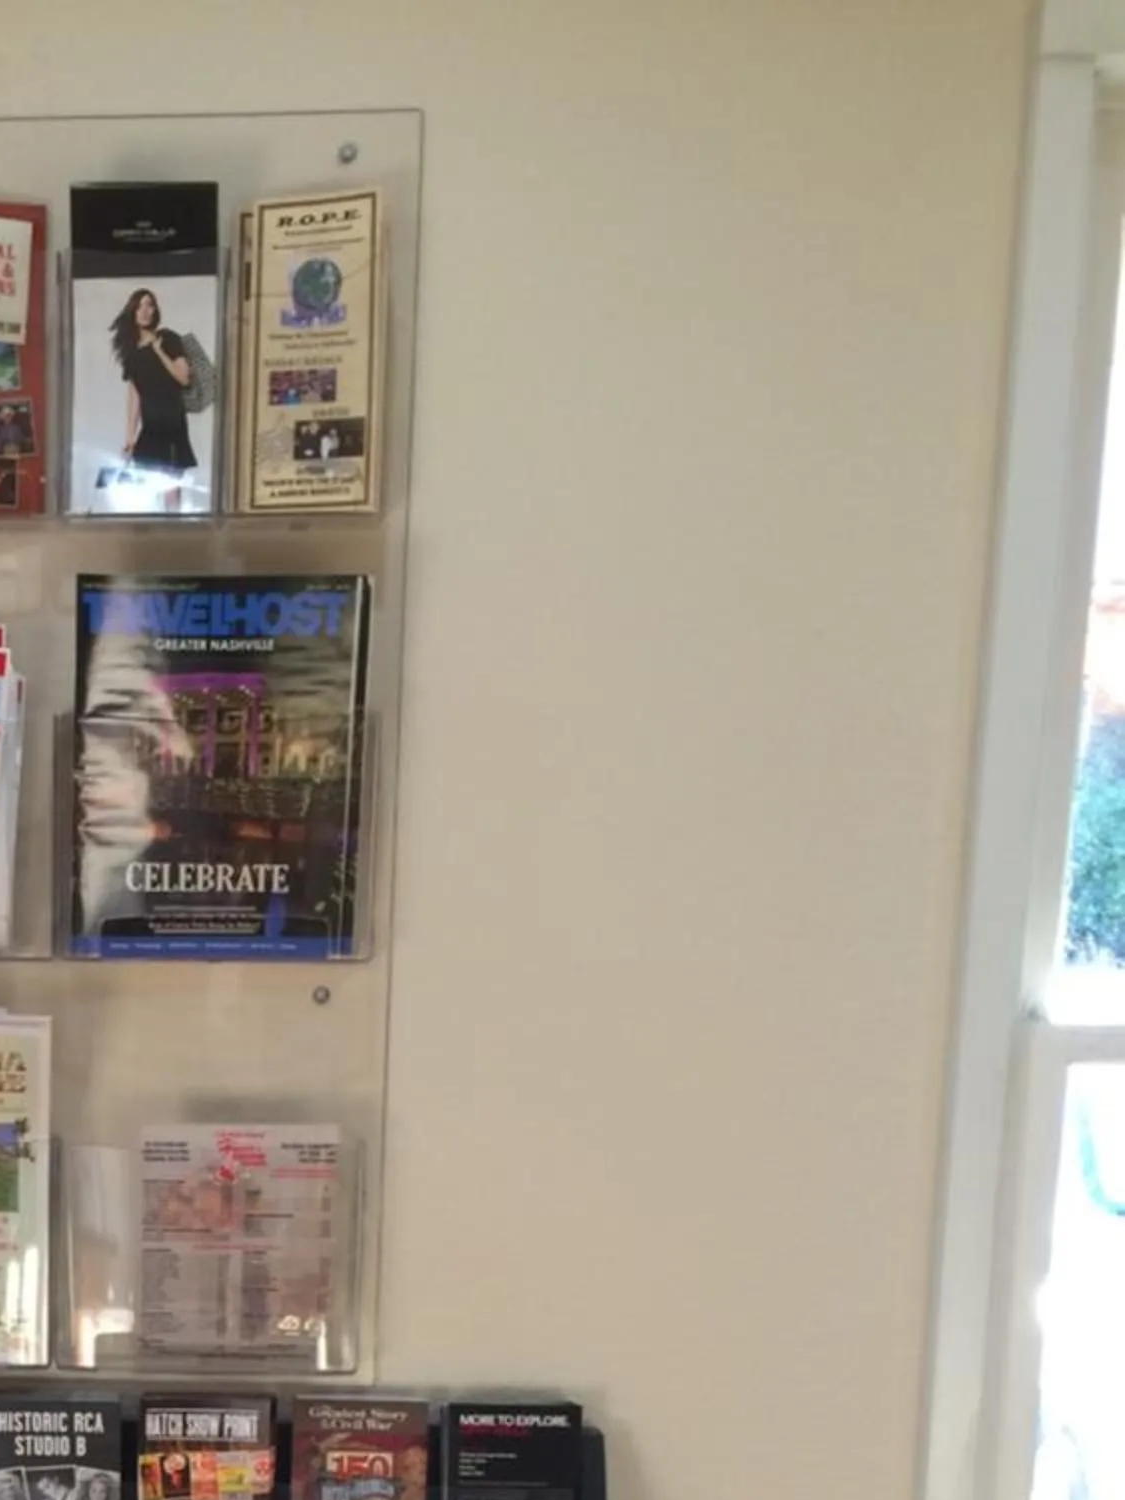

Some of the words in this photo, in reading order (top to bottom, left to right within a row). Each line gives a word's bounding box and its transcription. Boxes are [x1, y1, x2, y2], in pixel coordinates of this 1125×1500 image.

[2, 262, 14, 278] &
[154, 638, 208, 651] GREATER
[210, 638, 274, 651] NASHVILLE
[125, 861, 291, 893] CELEBRATE
[73, 1411, 105, 1434] RCA
[185, 1411, 222, 1441] SHOW
[223, 1412, 259, 1442] PRINT
[459, 1413, 495, 1427] MORE
[497, 1414, 515, 1427] TO
[13, 1435, 70, 1457] STUDIO
[74, 1436, 88, 1457] B
